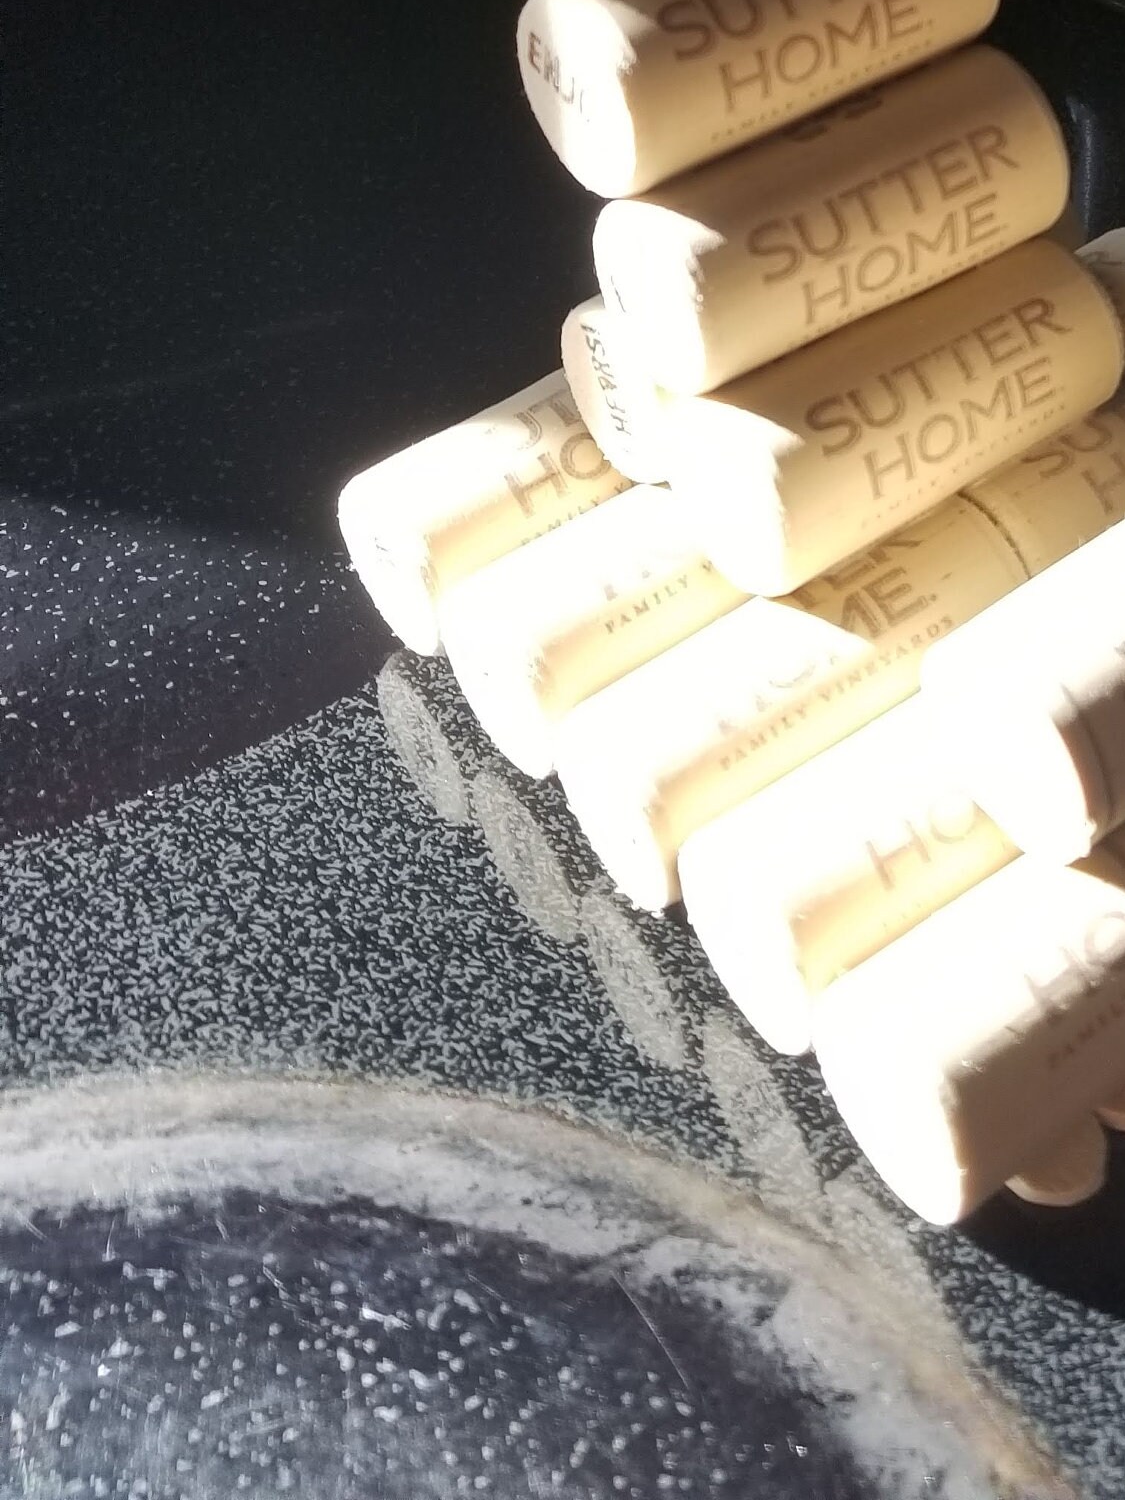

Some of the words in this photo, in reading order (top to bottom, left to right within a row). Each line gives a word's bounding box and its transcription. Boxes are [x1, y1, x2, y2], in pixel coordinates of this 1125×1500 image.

[747, 124, 1020, 285] SUTTER
[801, 192, 1002, 325] HOME
[805, 297, 1072, 458] SUTTER
[863, 357, 1055, 500] HOME
[503, 431, 612, 520] HO
[604, 573, 690, 635] FAMILY
[719, 702, 807, 771] FAMILY
[818, 613, 954, 702] VINEYARDS
